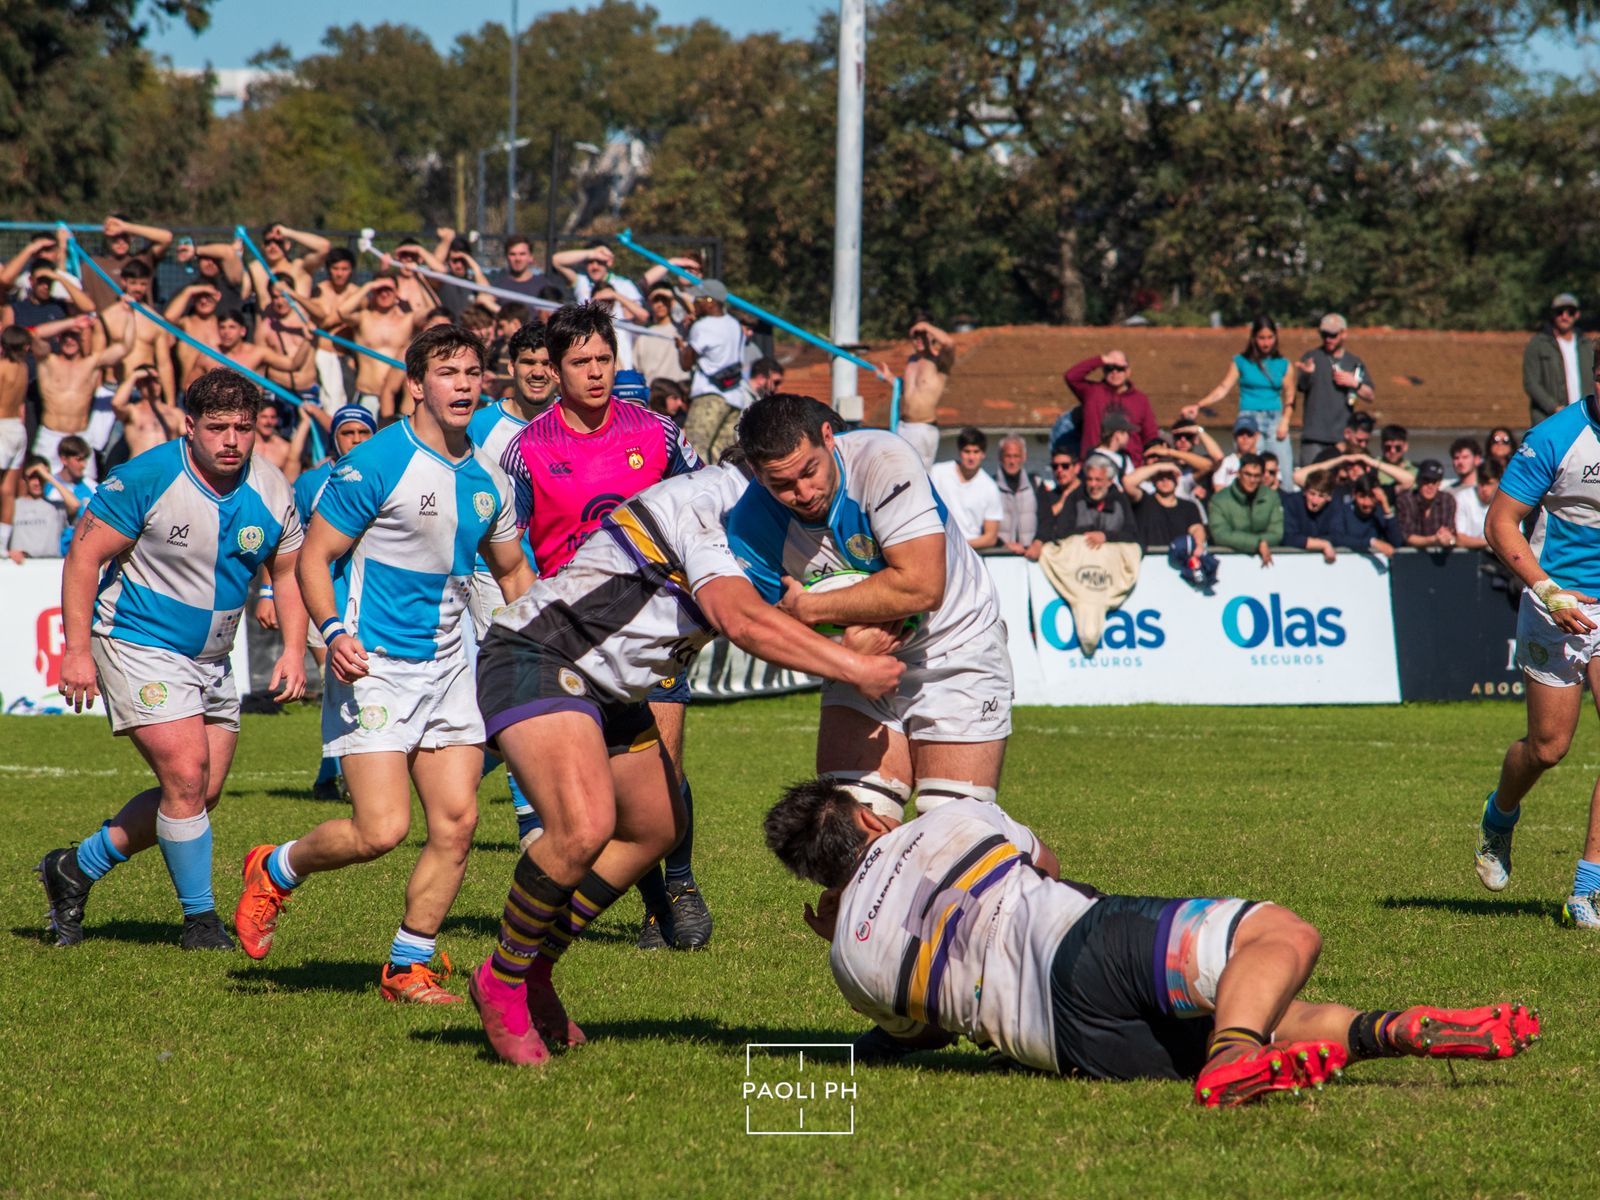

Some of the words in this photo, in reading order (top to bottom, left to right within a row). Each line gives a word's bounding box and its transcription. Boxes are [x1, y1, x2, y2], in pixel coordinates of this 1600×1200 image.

[1041, 597, 1166, 651] Oas
[1222, 592, 1346, 648] Olas
[1250, 654, 1324, 666] SEGUROS
